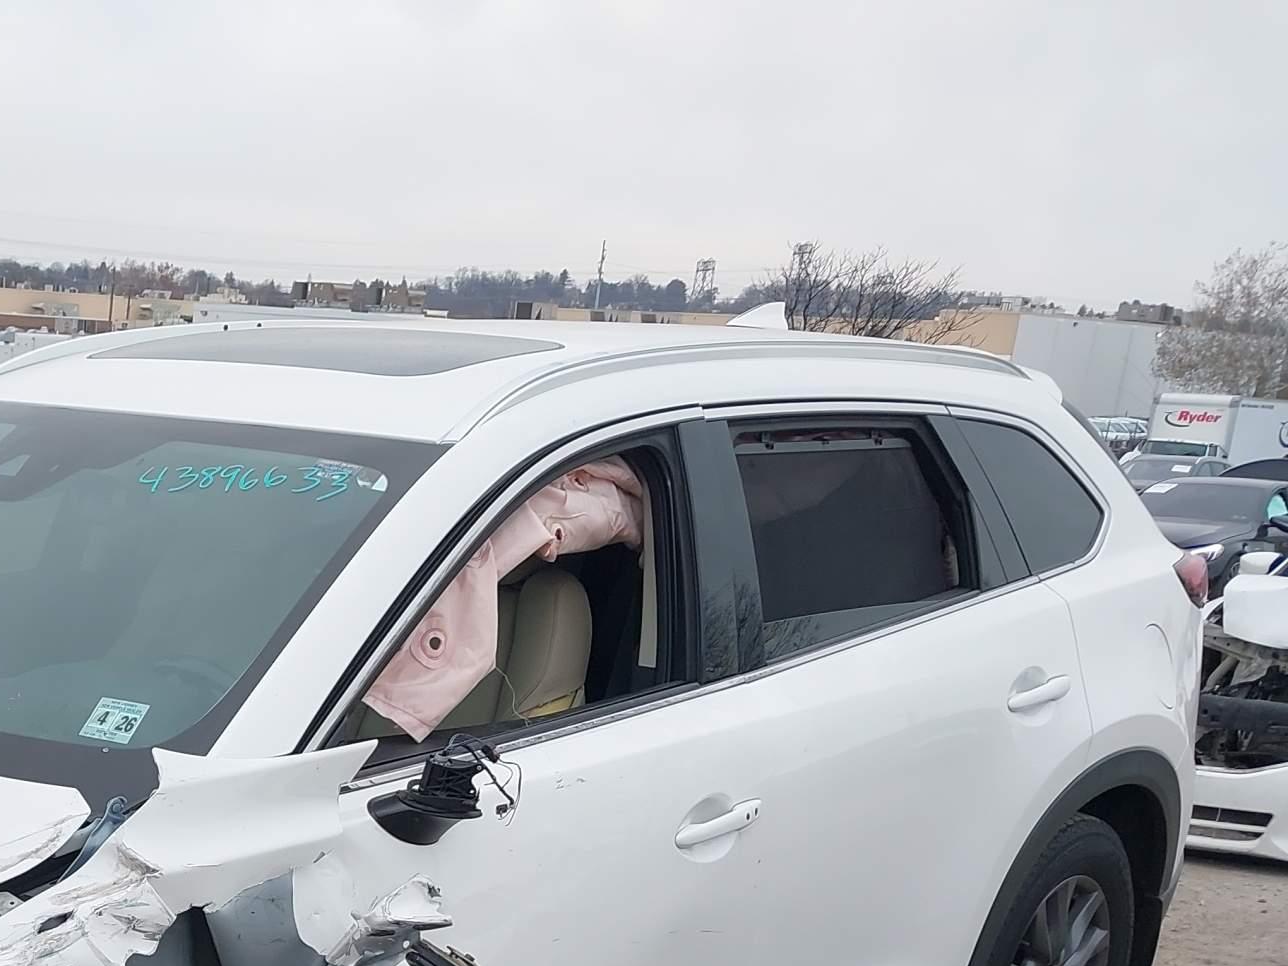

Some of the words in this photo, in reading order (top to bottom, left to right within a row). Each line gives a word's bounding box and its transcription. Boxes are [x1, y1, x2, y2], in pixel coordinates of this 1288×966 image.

[1178, 410, 1222, 424] Ryder
[138, 464, 352, 502] 43896633
[97, 710, 111, 726] 4
[114, 715, 138, 733] 26
